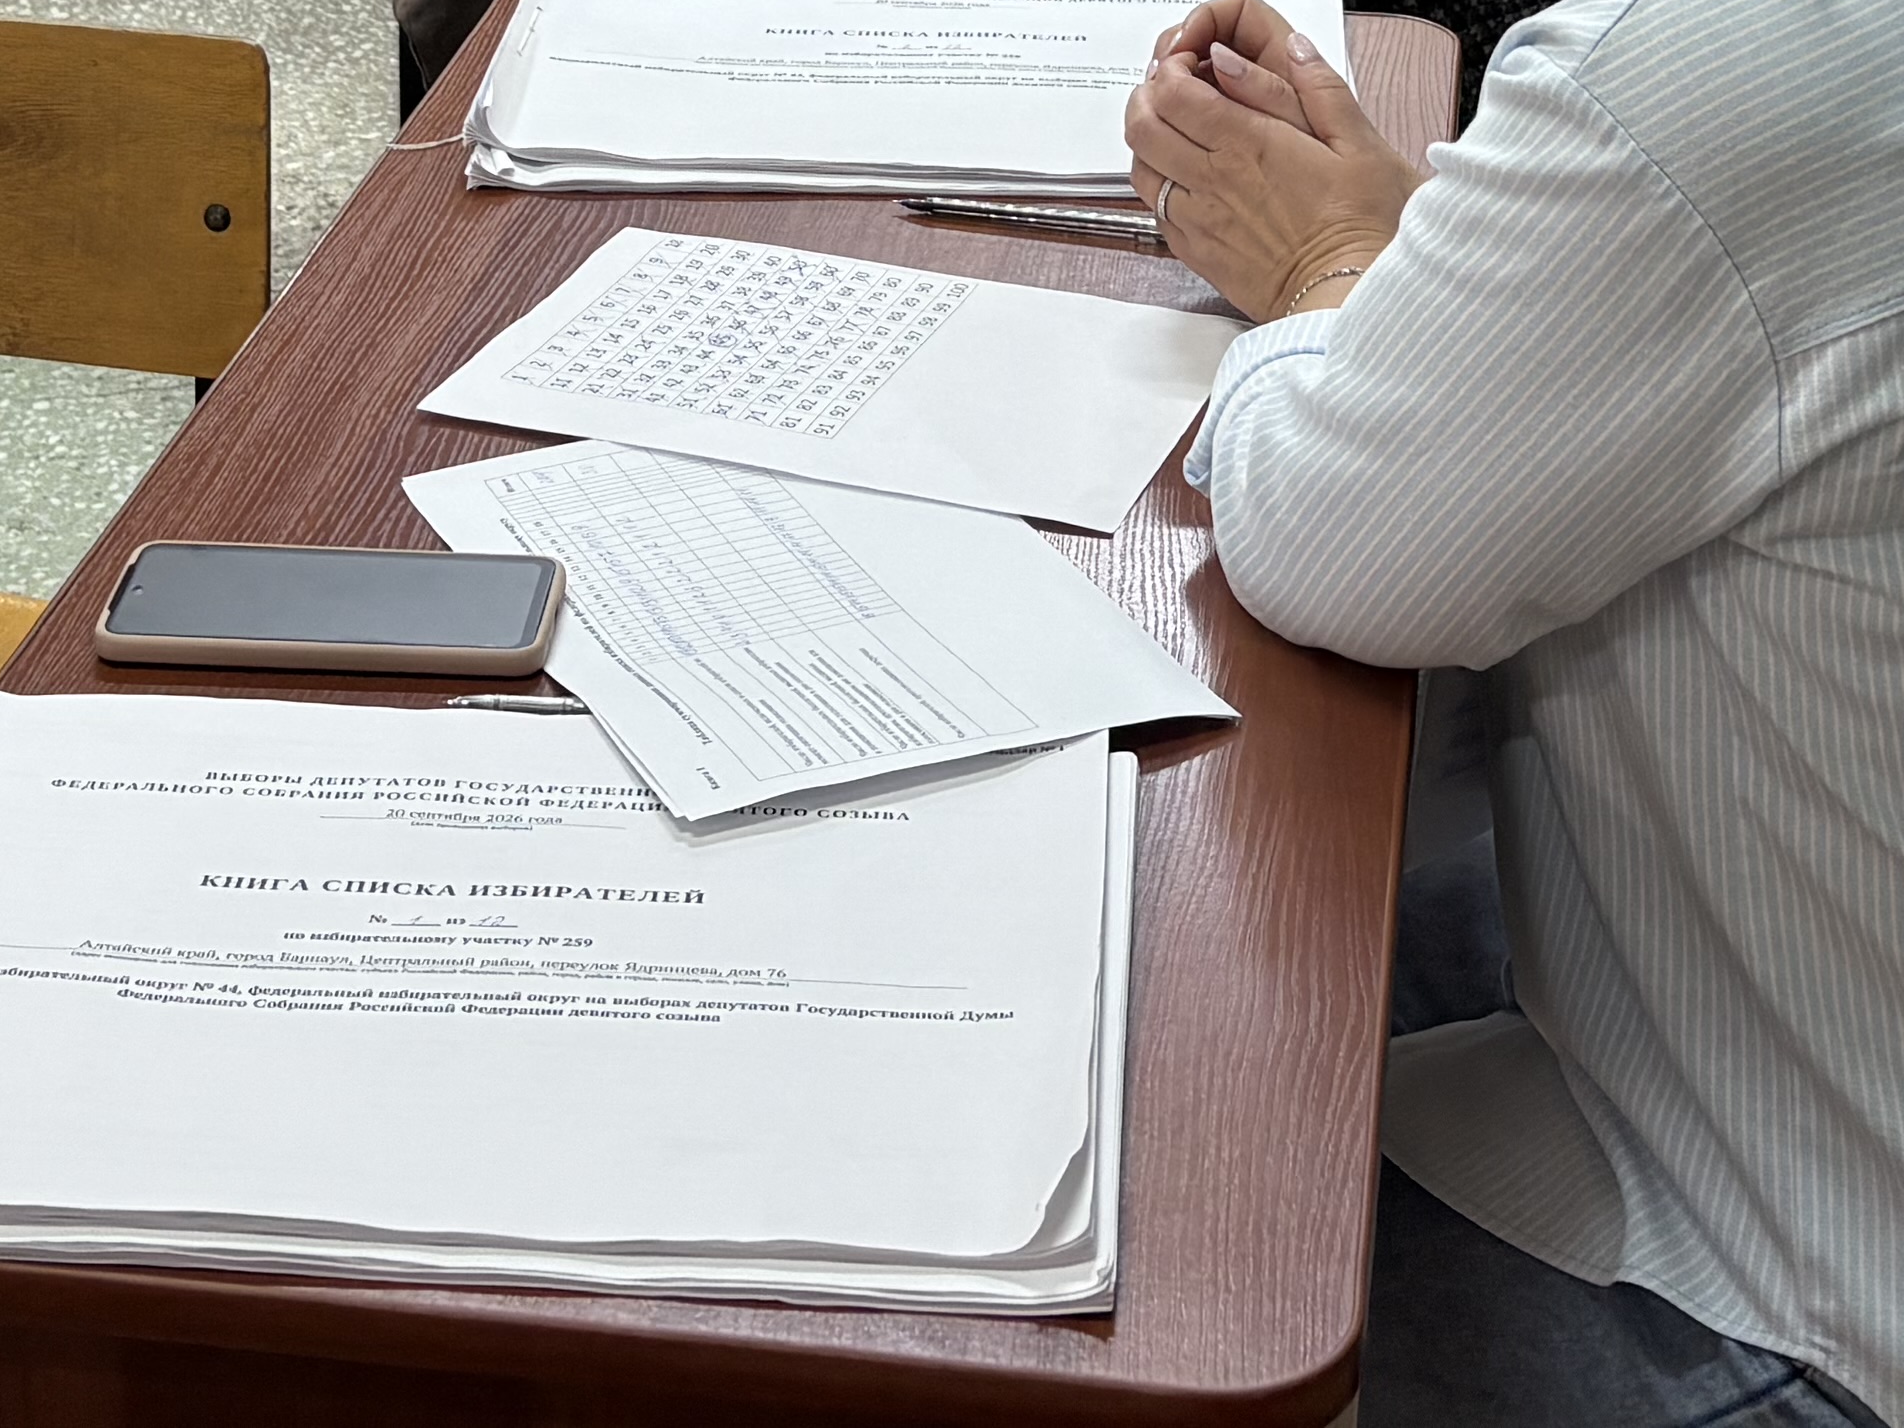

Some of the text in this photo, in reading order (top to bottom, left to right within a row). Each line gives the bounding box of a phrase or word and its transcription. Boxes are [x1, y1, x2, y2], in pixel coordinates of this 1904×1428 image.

[812, 282, 969, 436] 91 92 93 94 95 96 97 98 99 100
[50, 778, 235, 796] ФЕДЕРАЛЬНОГО
[242, 787, 365, 801] СОБРАНИЯ
[373, 791, 530, 807] РОССИЙСКОЙ
[539, 799, 667, 812] ФЕДЕРАЦИ
[817, 809, 911, 821] СОЗЫВА
[204, 771, 653, 798] ВЫБОРЫ ДЕПУТАТОВ ГОСУДАРСТВЕНН
[527, 816, 563, 826] года
[199, 875, 707, 905] КНИГА СПИСКА ИЗБИРАТЕЛЕЙ
[368, 914, 388, 924] №
[447, 917, 466, 925] из
[283, 931, 594, 948] по избирательному участку № 259
[78, 939, 173, 957] Алтайский
[177, 949, 221, 961] край,
[226, 953, 274, 964] город
[480, 957, 535, 969] район,
[540, 960, 619, 973] переулок
[725, 968, 762, 979] дом
[766, 968, 787, 978] 76
[116, 988, 721, 1023] Федерального Собрания Российской Федерации девятого созыва
[134, 979, 188, 991] округ
[192, 982, 213, 992] №
[217, 985, 243, 995] 44,
[248, 985, 374, 1000] федеральный
[378, 989, 523, 1002] избирательный
[526, 994, 581, 1005] округ
[585, 996, 607, 1005] на
[612, 997, 691, 1009] выборах
[695, 1000, 791, 1014] депутатов
[795, 1003, 955, 1021] Государственной
[959, 1011, 1015, 1023] Думы
